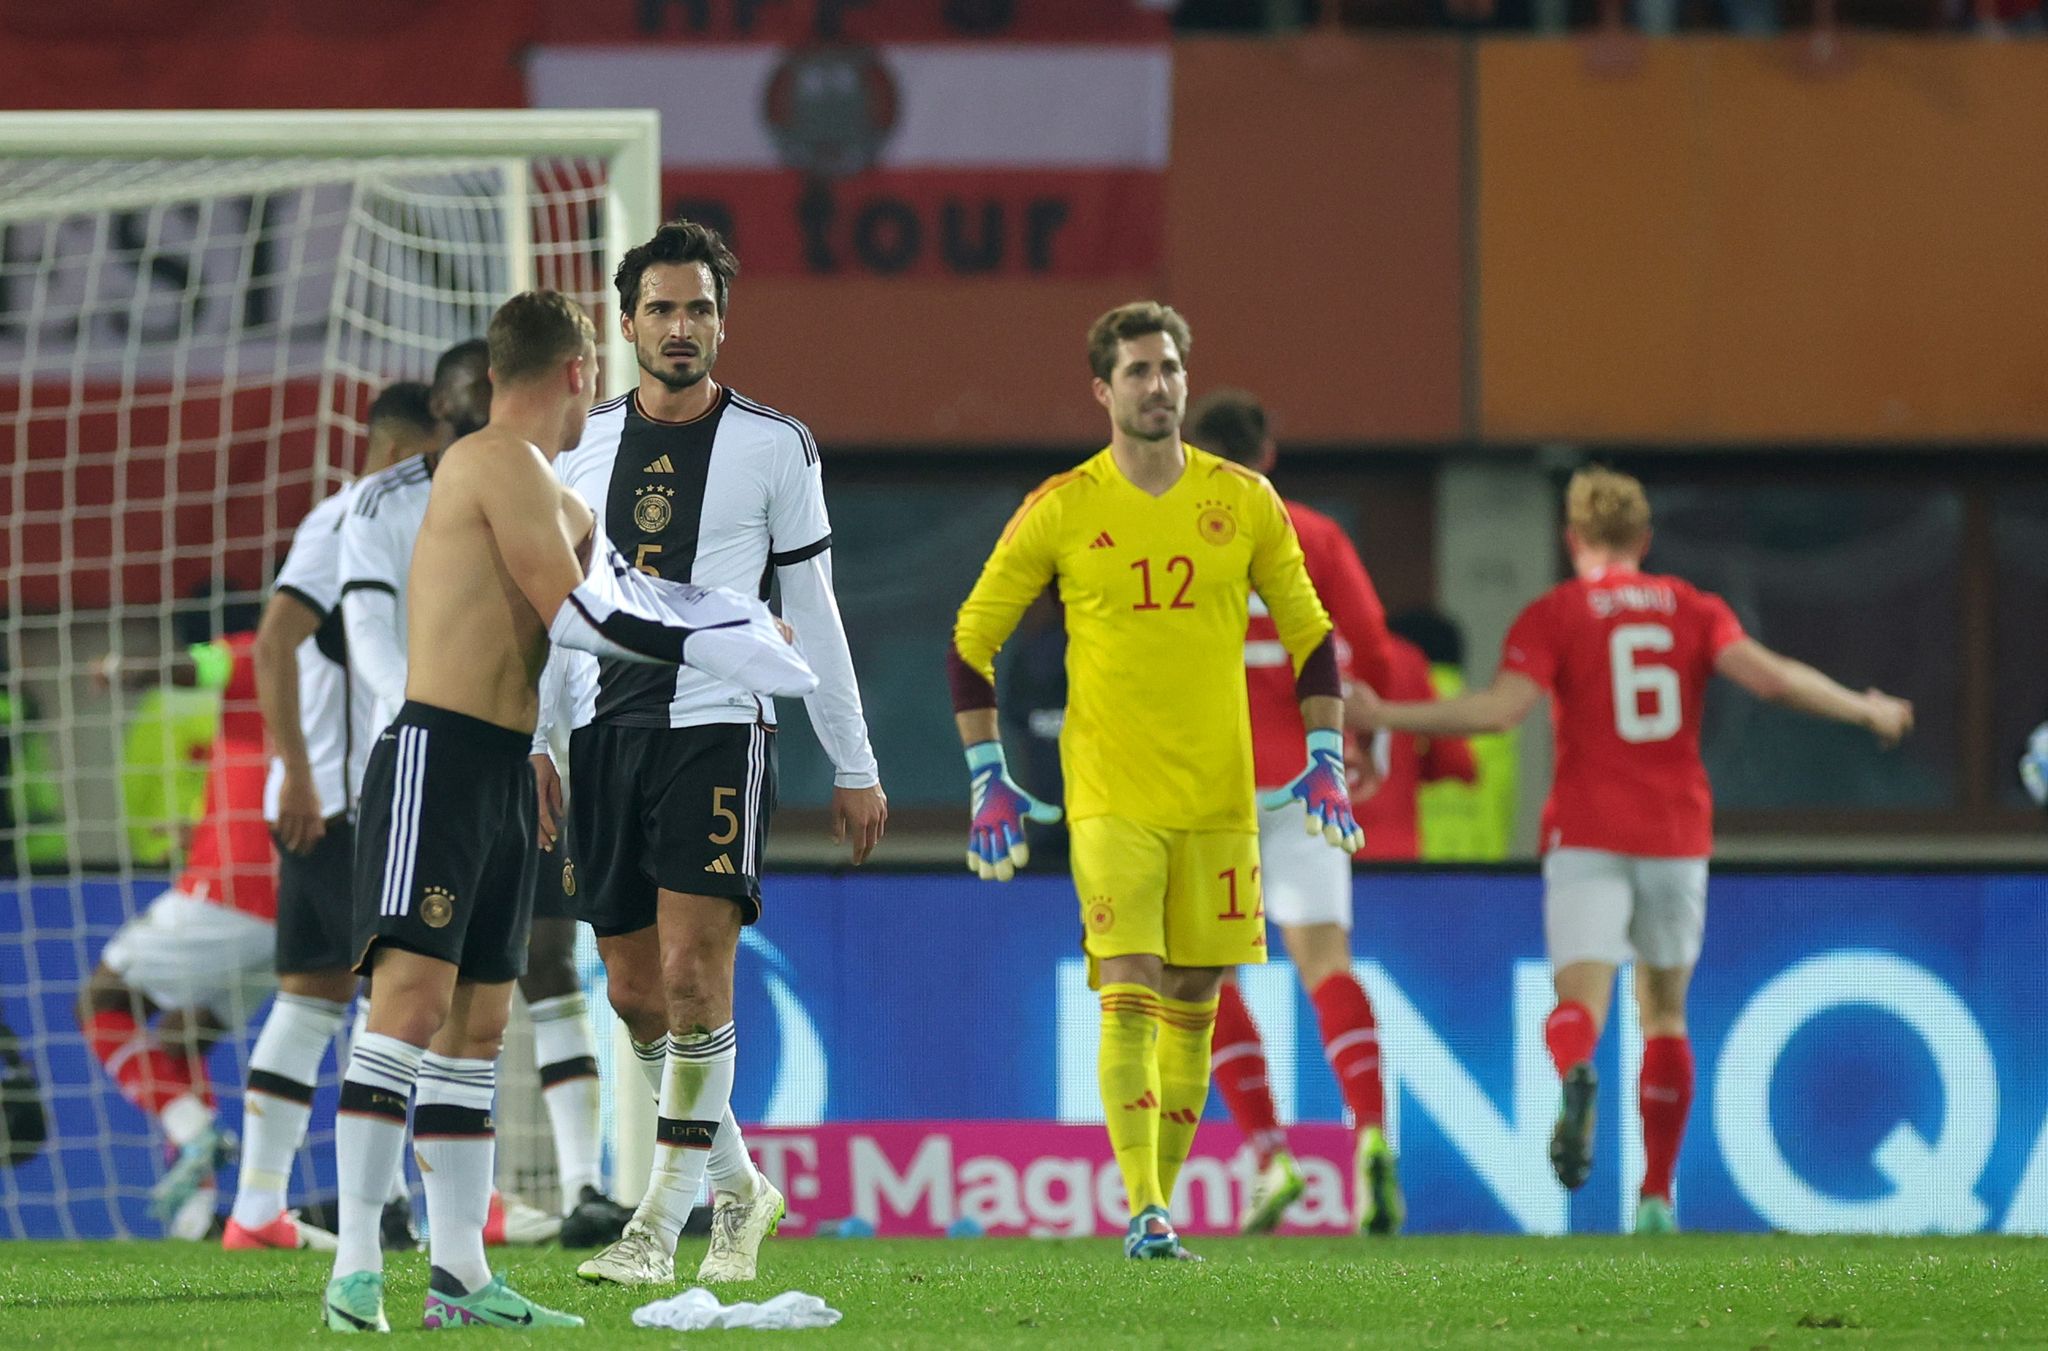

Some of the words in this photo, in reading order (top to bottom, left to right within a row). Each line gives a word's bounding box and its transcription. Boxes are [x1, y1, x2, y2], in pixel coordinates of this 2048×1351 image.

[799, 178, 1070, 278] tour
[1130, 555, 1197, 611] 12
[1609, 623, 1682, 743] 6
[708, 786, 739, 845] 5
